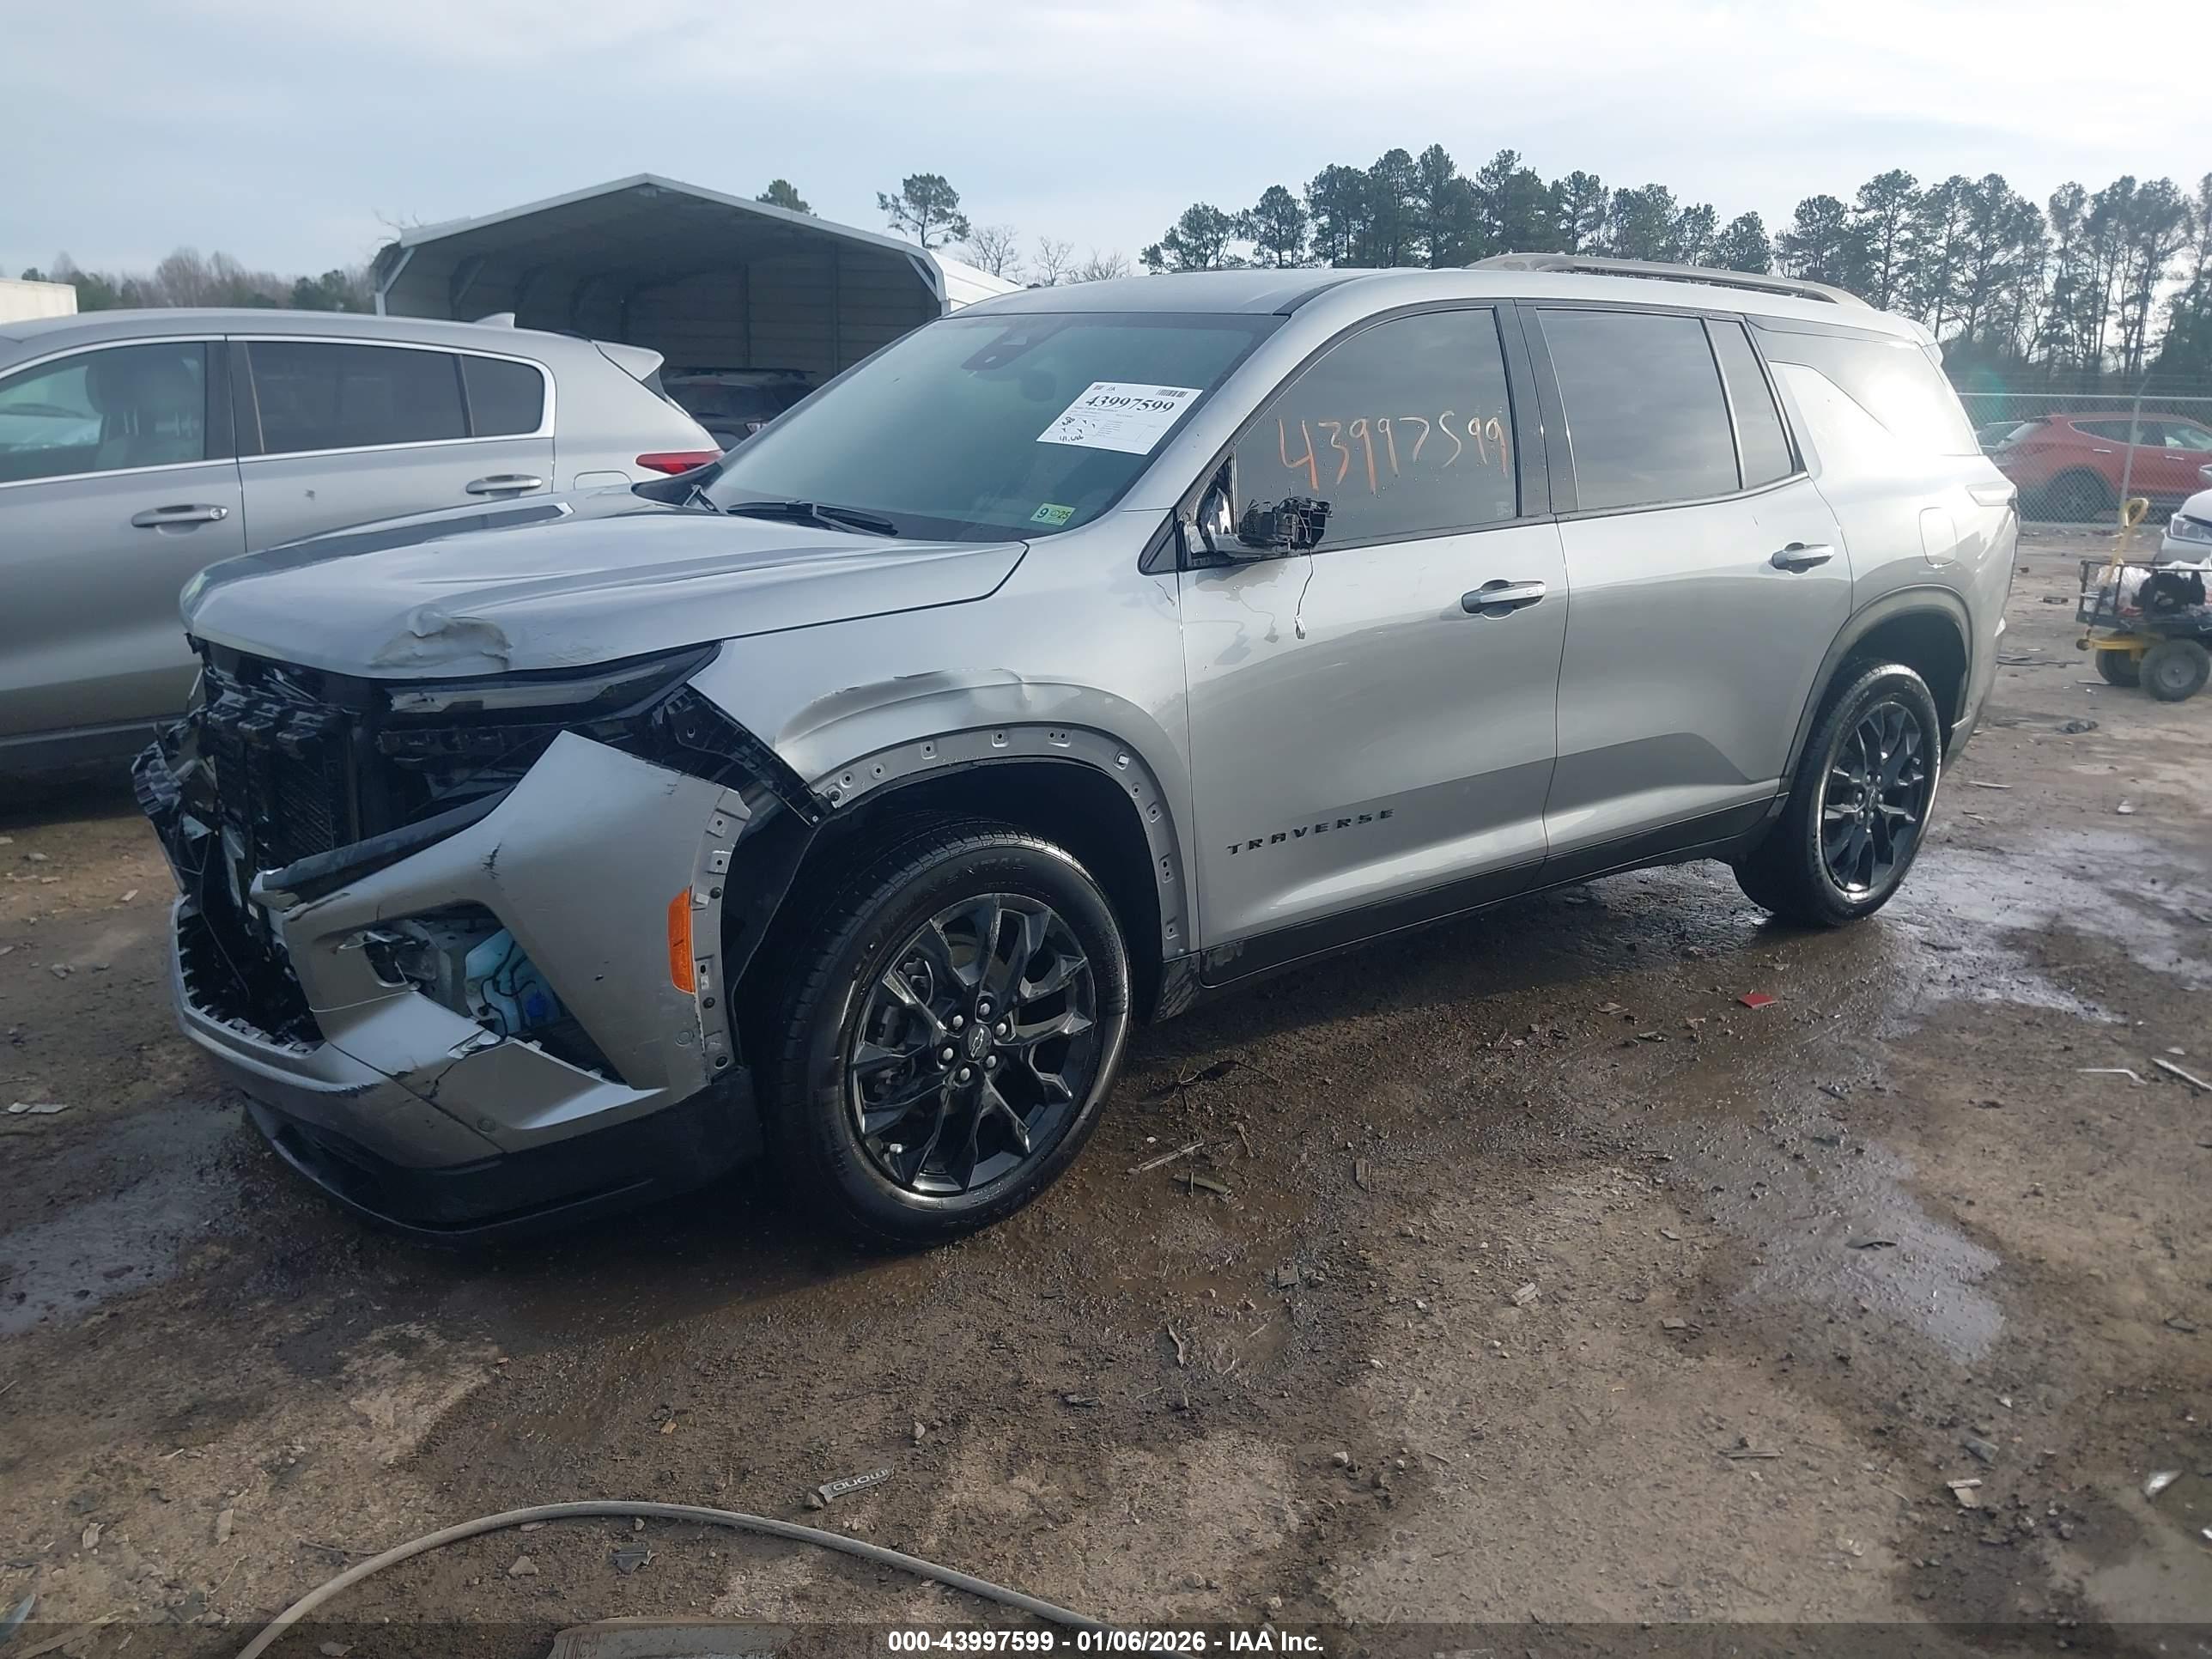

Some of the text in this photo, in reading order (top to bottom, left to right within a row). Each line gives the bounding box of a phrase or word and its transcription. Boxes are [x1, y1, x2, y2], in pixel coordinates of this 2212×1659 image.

[1085, 394, 1176, 414] 43997599
[1278, 410, 1508, 495] 43997599
[1036, 507, 1071, 520] 9 25
[1227, 808, 1395, 856] TRAVERSE
